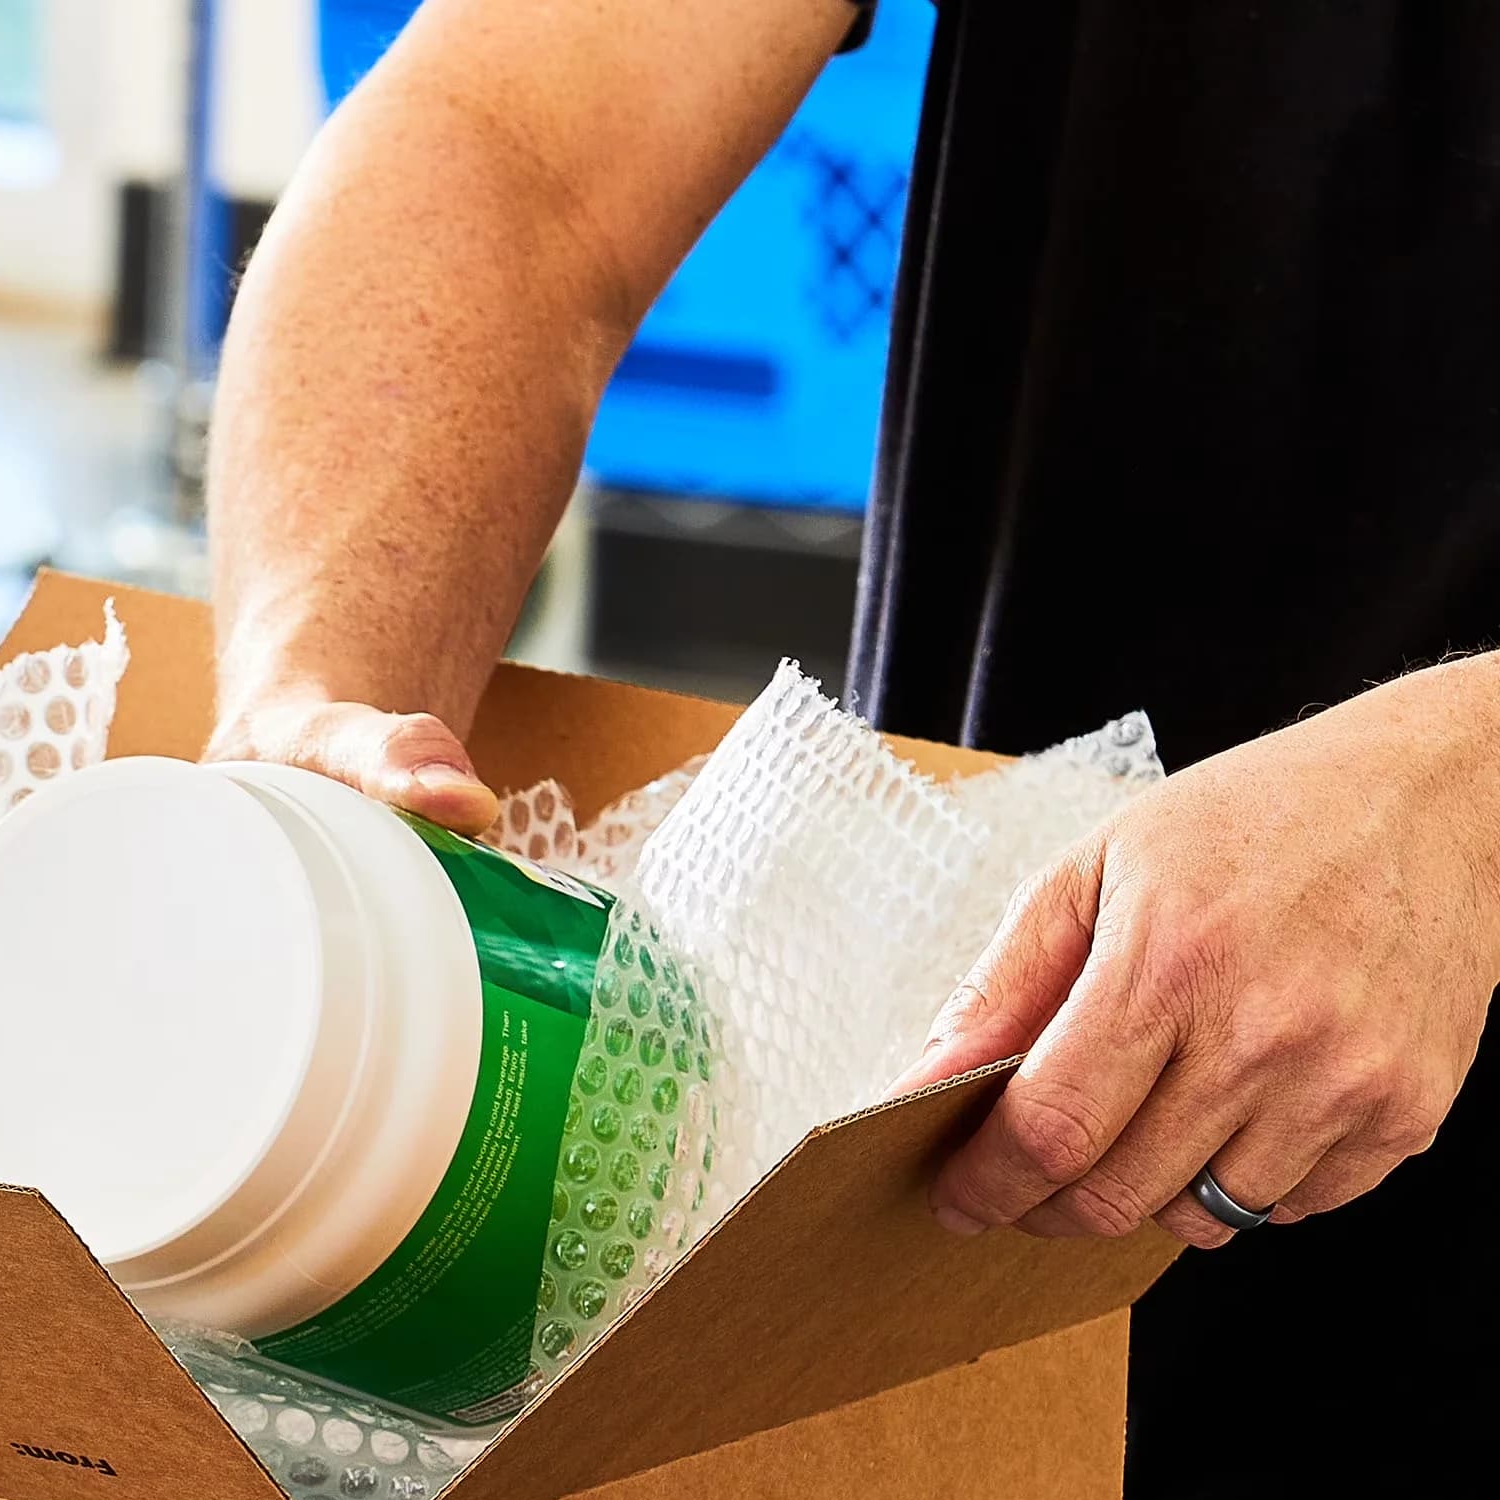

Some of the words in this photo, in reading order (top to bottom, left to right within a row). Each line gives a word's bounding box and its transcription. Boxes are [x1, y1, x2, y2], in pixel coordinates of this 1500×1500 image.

[453, 1199, 461, 1210] or
[461, 1172, 475, 1196] your
[472, 1129, 493, 1171] favorite
[490, 1101, 500, 1127] cold
[502, 1010, 510, 1038] Then
[461, 1220, 471, 1230] to
[470, 1196, 485, 1217] stay
[504, 1120, 515, 1140] For
[511, 1092, 522, 1118] best
[470, 1141, 499, 1200] completely
[508, 1050, 520, 1082] Enjoy
[469, 1202, 493, 1237] protein
[492, 1133, 522, 1199] supplement.
[10, 1442, 118, 1477] From:
